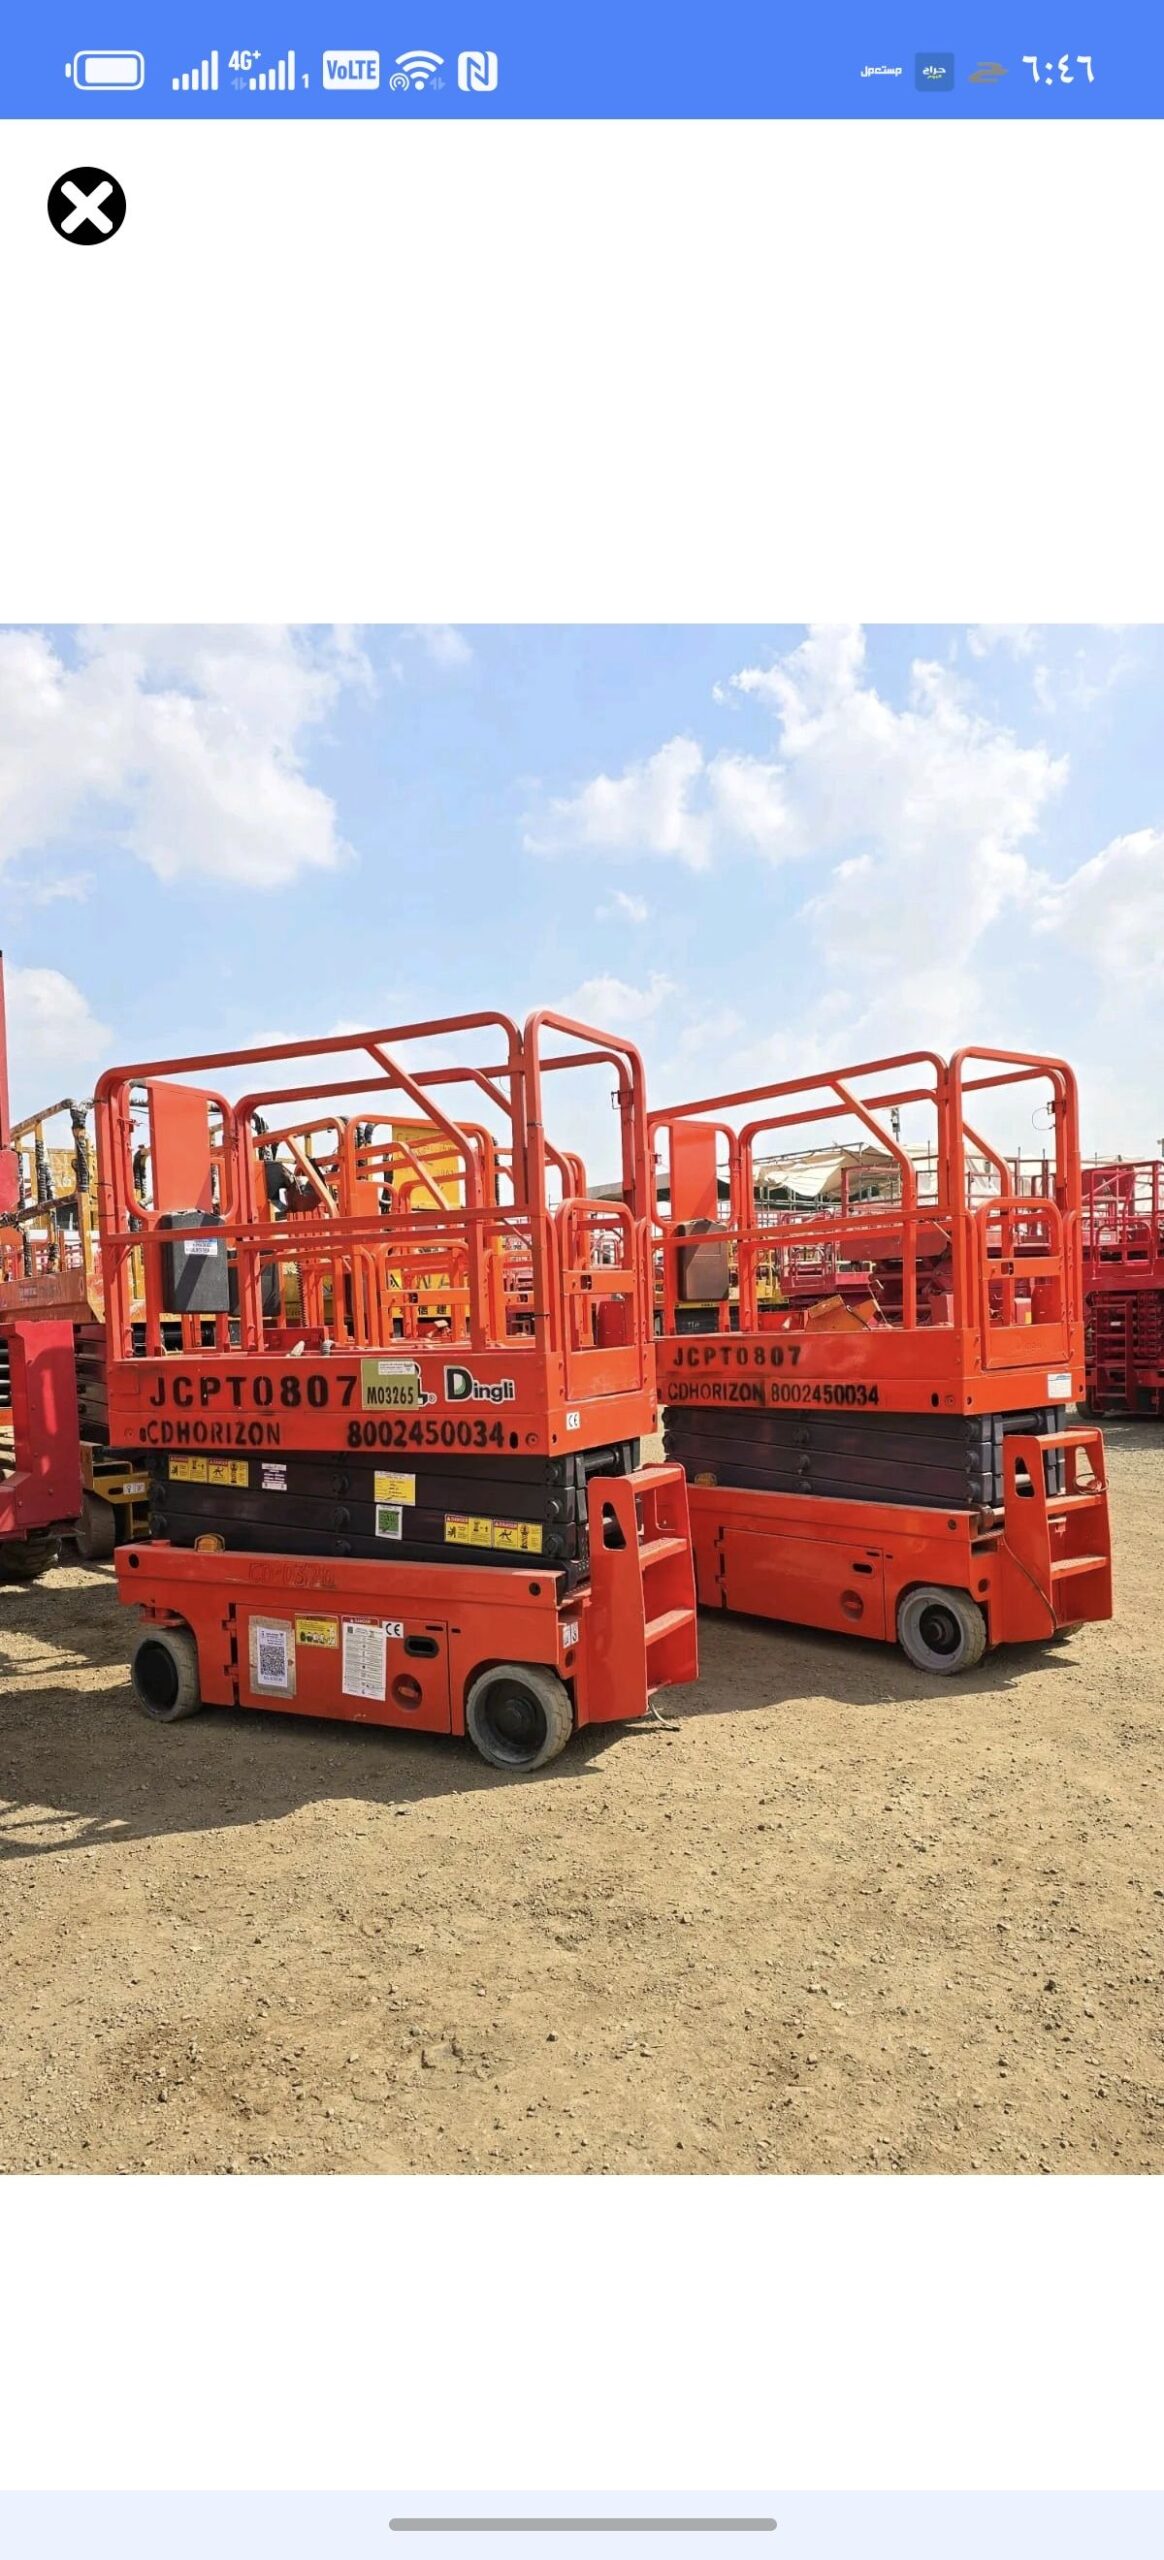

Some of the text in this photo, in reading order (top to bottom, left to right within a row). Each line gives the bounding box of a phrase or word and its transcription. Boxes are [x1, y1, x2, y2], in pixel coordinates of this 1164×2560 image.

[673, 1346, 802, 1367] JCPT0807
[150, 1375, 358, 1408] JCPT0807
[367, 1386, 414, 1405] M03265
[446, 1368, 514, 1402] Dingli
[668, 1382, 879, 1406] CDHORIZON 8002450034
[147, 1420, 504, 1448] CDHORIZON 8002450034
[385, 1622, 401, 1637] CE
